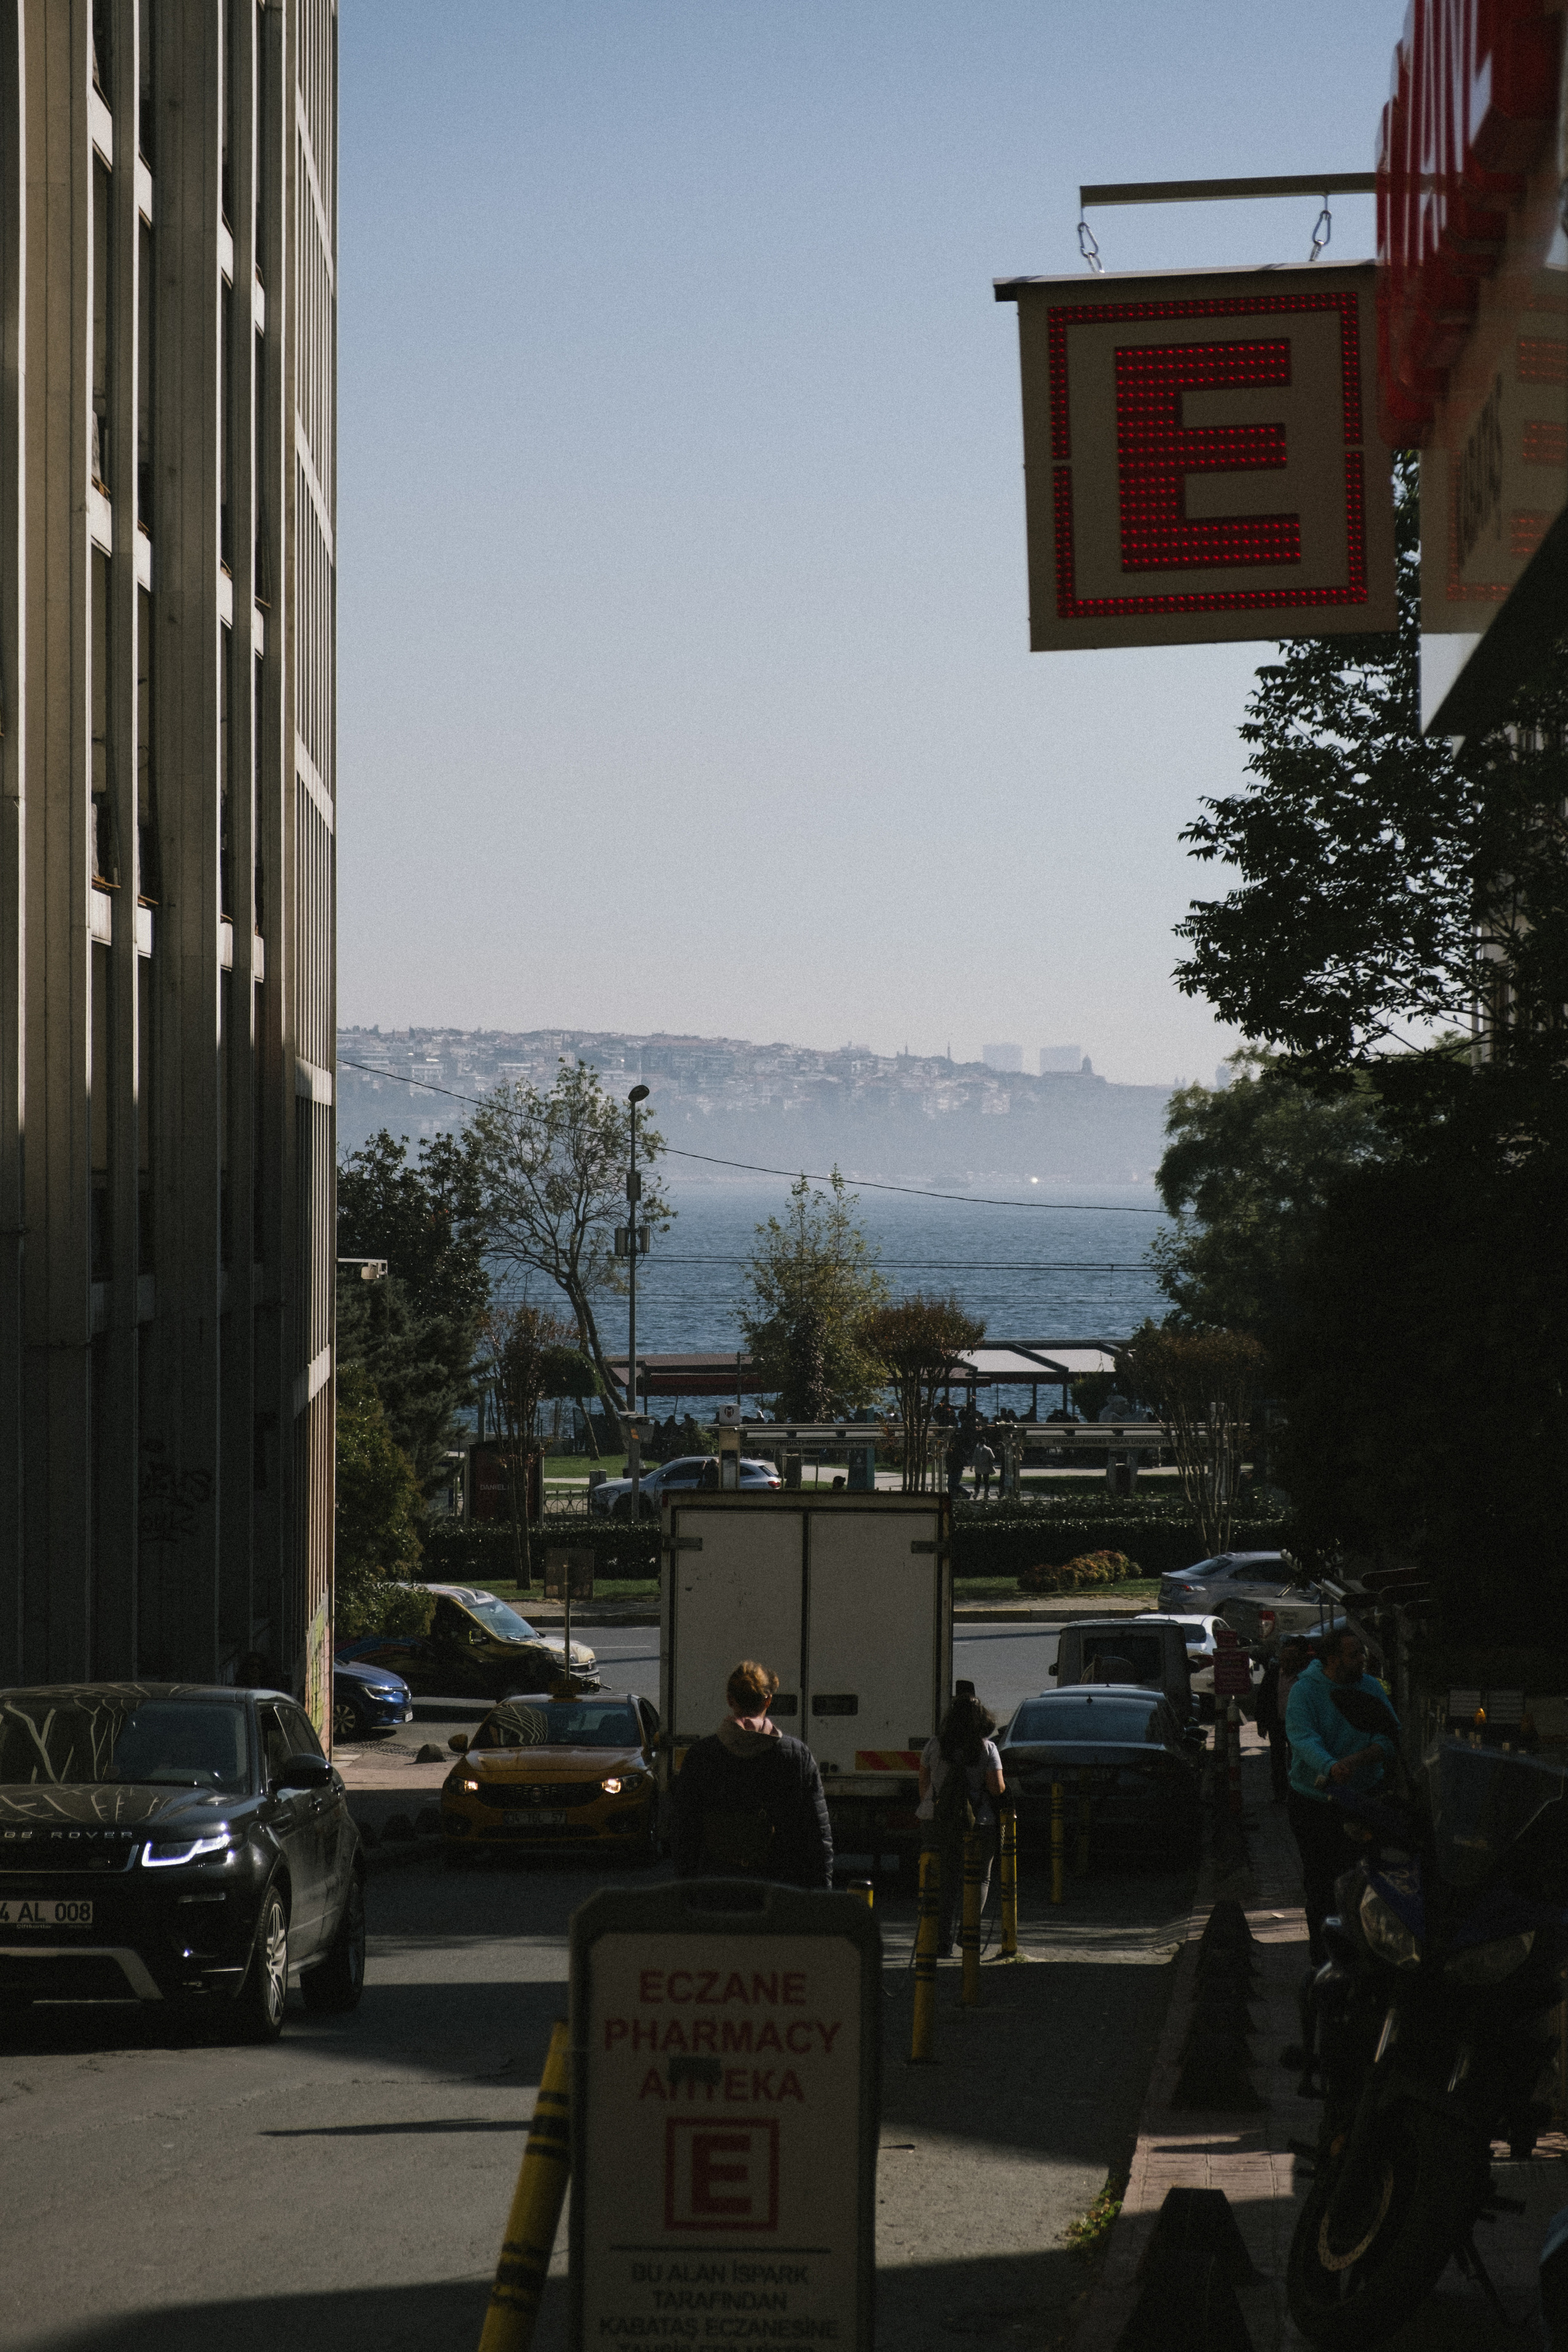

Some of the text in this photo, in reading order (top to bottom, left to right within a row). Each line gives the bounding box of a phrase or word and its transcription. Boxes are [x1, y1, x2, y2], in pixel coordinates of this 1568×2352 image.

[1114, 338, 1300, 573] E
[552, 1812, 564, 1823] 57
[18, 1903, 46, 1922] AL
[55, 1903, 91, 1922] 008
[639, 1971, 807, 2005] ECZANE
[604, 2019, 842, 2053] PHARMACY
[692, 2135, 752, 2214] E
[631, 2263, 661, 2282] BU
[667, 2263, 725, 2283] ALAN
[653, 2290, 787, 2311] TARAFINDAN
[600, 2318, 698, 2339] KABATAŞ
